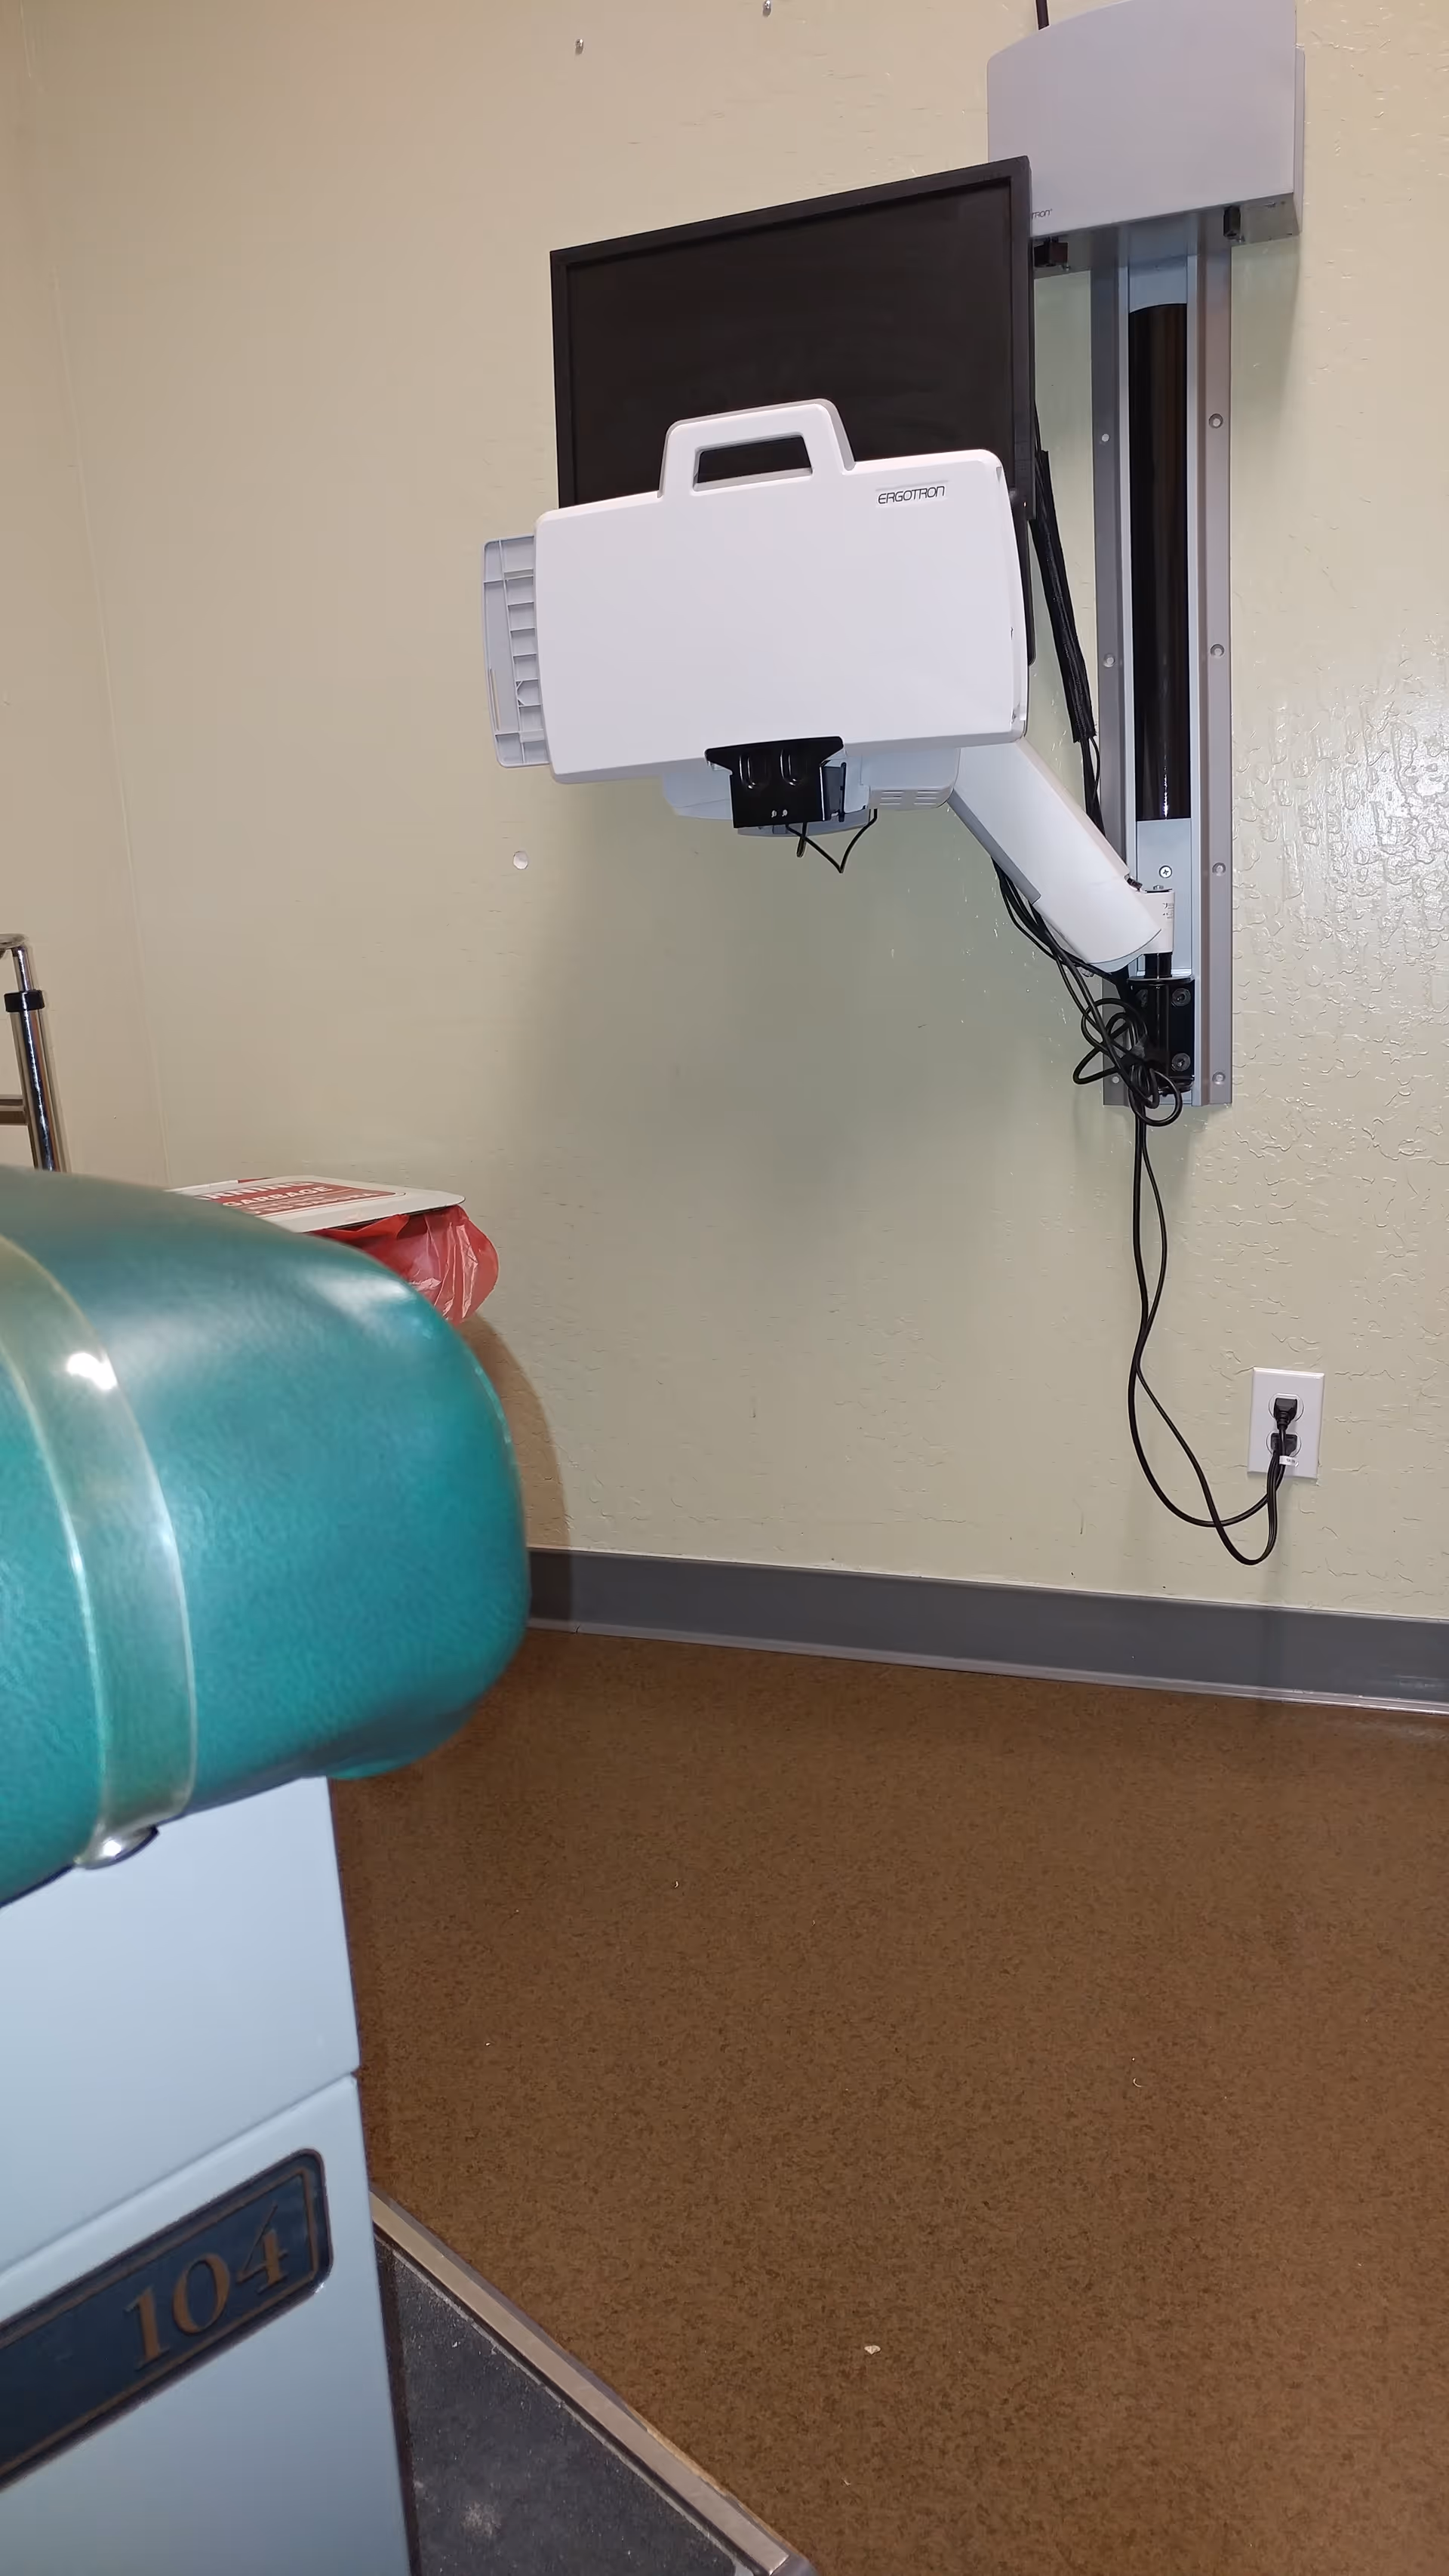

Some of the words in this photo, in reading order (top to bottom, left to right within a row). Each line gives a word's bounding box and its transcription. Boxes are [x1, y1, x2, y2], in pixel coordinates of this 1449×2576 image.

[878, 485, 945, 504] ERGOTRON
[222, 1186, 333, 1207] GARBAGE
[123, 2202, 288, 2371] 104
